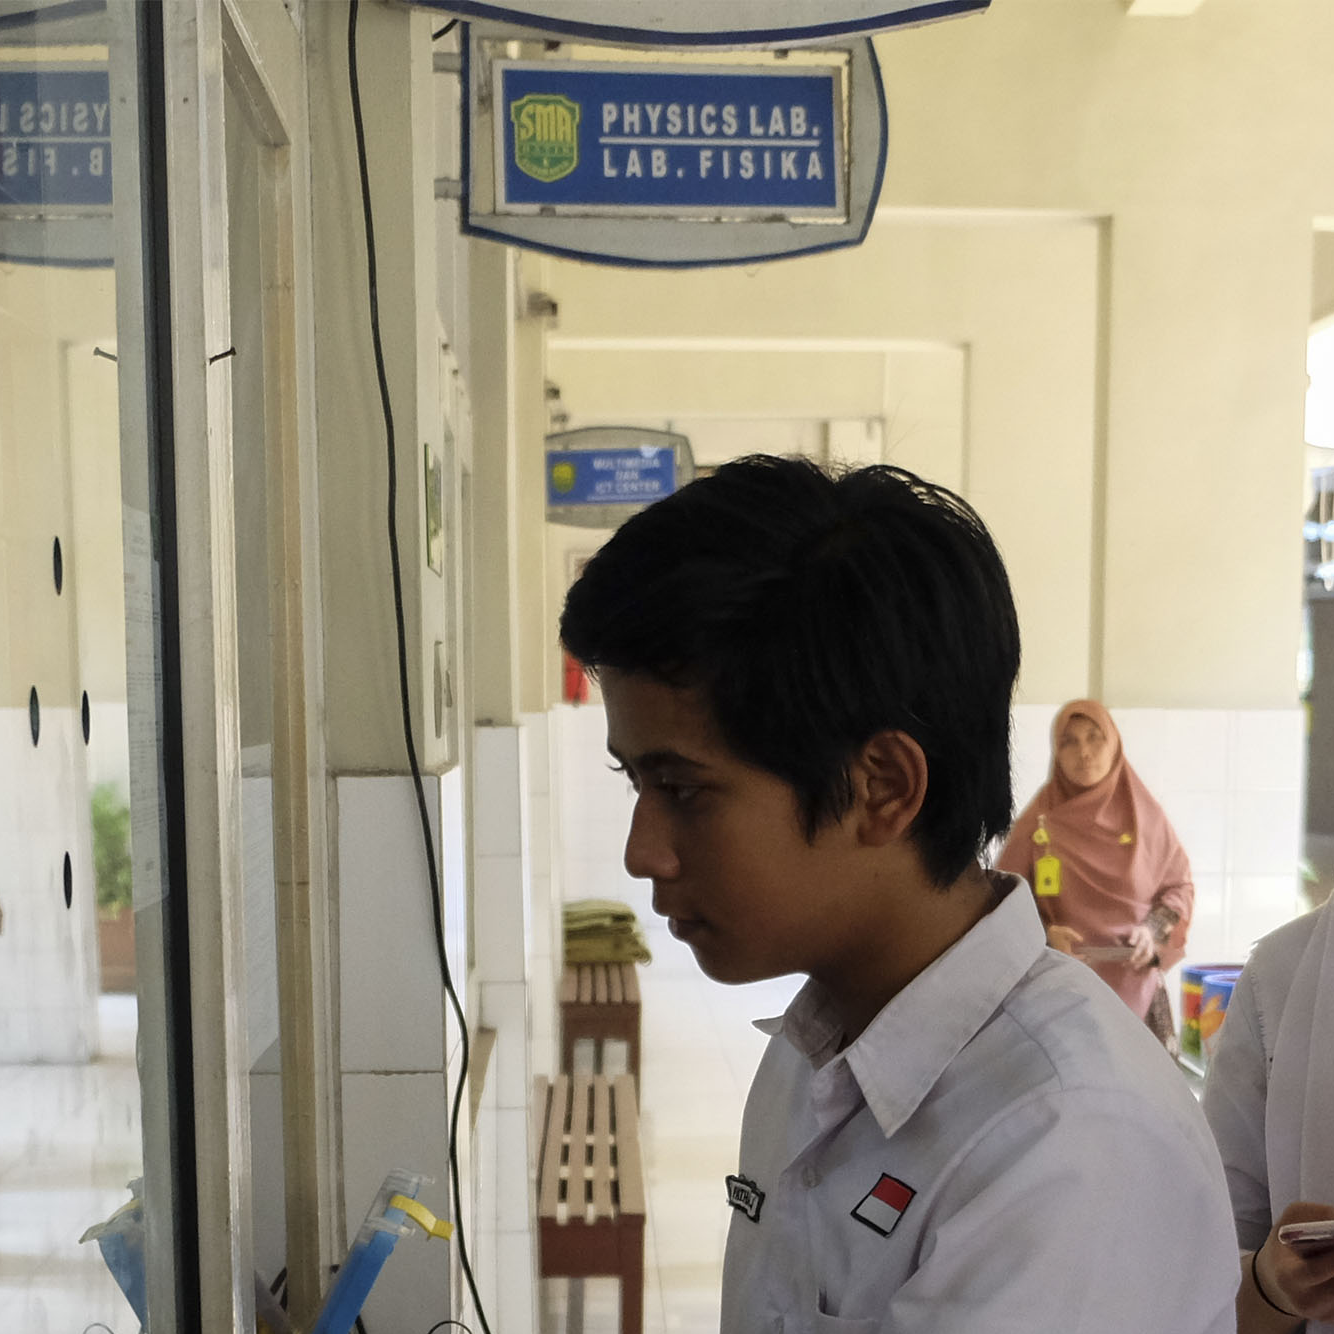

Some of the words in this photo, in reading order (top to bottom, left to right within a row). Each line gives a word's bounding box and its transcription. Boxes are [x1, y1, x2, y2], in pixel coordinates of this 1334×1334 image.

[520, 105, 572, 140] SMA
[602, 103, 738, 136] PHYSICS
[748, 104, 821, 137] LAB.
[603, 149, 685, 179] LAB.
[700, 150, 824, 180] FISIKA
